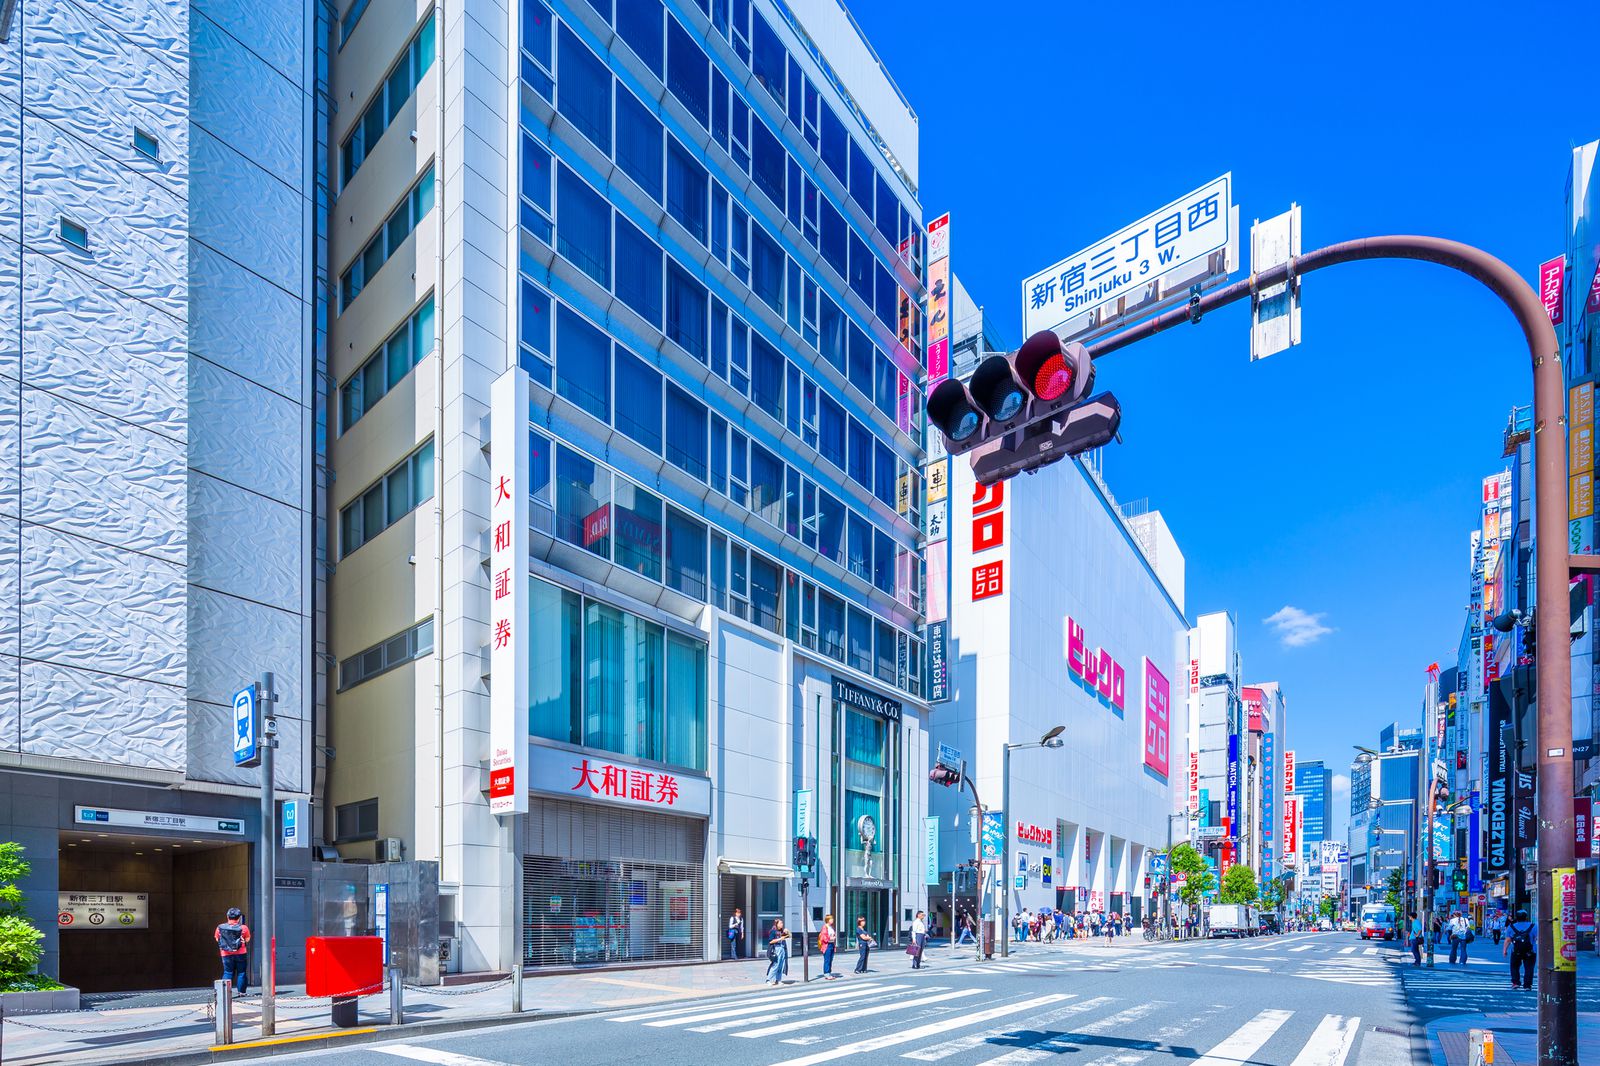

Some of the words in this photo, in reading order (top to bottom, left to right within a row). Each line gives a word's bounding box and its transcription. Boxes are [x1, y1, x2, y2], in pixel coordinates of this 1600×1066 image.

[1031, 192, 1220, 311] 新宿三丁目西
[1064, 269, 1132, 313] Shinjuku
[1140, 260, 1150, 276] 3
[1158, 245, 1180, 264] W.
[930, 469, 946, 491] 車
[494, 475, 511, 651] 大和証券
[1067, 616, 1125, 711] ビックロ
[571, 759, 679, 806] 大和証券
[1229, 761, 1237, 788] WATCH.
[1017, 820, 1052, 845] ビックカメラ
[1491, 777, 1506, 867] CALZEDONIA
[1576, 814, 1586, 843] 無印良品
[69, 895, 123, 903] 新宿三丁目駅
